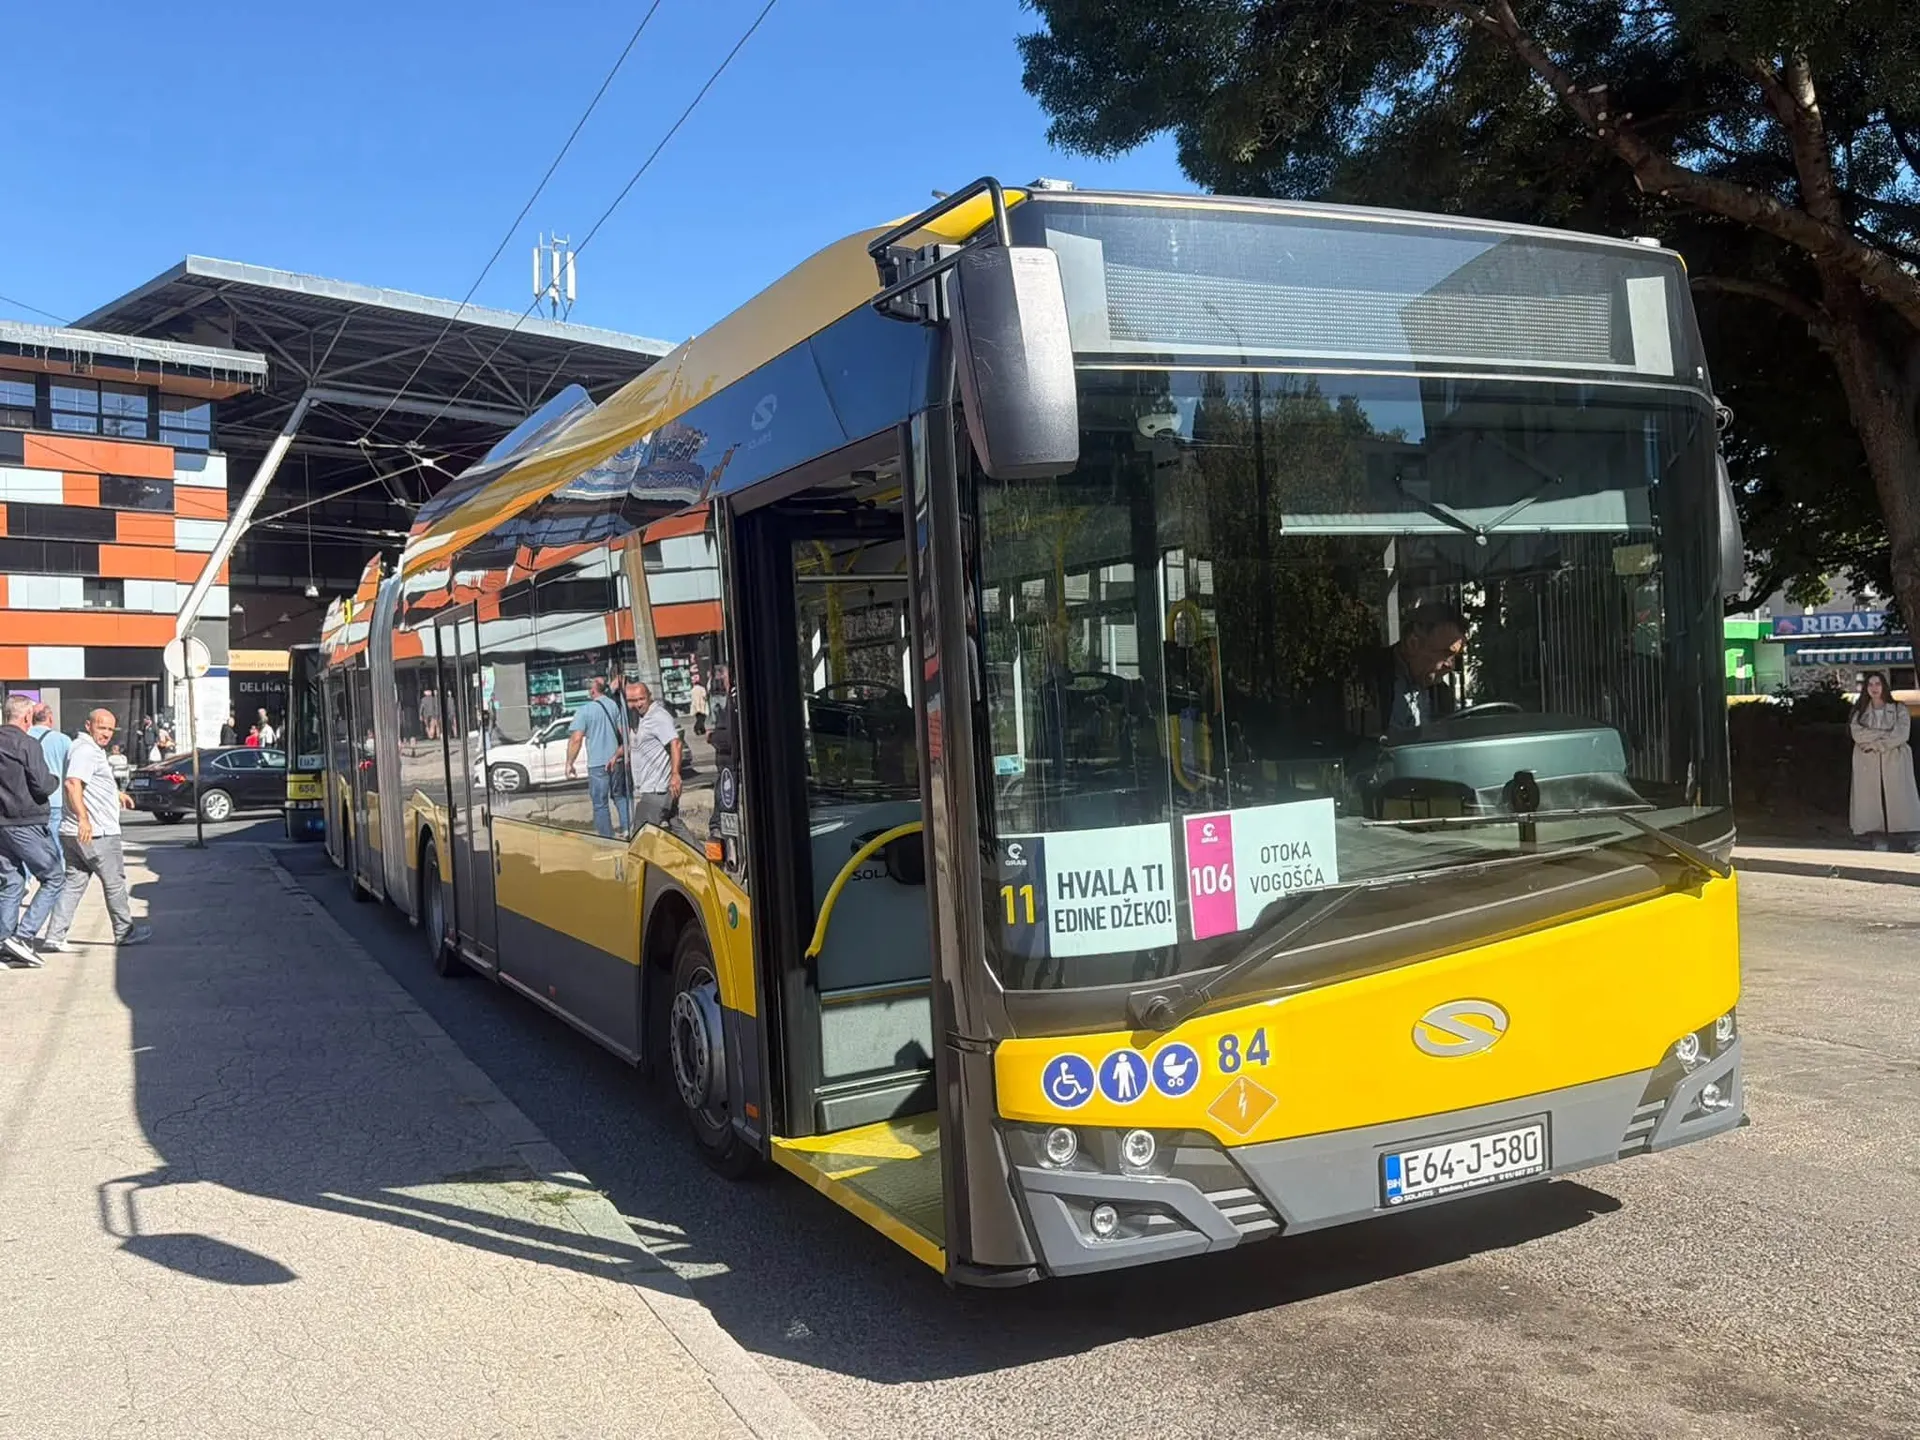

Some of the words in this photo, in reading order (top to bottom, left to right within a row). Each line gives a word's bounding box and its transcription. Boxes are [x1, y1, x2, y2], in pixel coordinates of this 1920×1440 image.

[1260, 841, 1312, 864] OTOKA
[1057, 867, 1138, 900] HVALA
[1142, 864, 1164, 892] TI
[1191, 864, 1233, 896] 106
[1250, 863, 1325, 894] VOGOŠĆA
[1000, 885, 1035, 924] 11
[1055, 906, 1107, 933] EDINE
[1110, 899, 1172, 929] DŽEKO!
[1218, 1027, 1270, 1073] 84
[1404, 1131, 1538, 1188] E64-J-580
